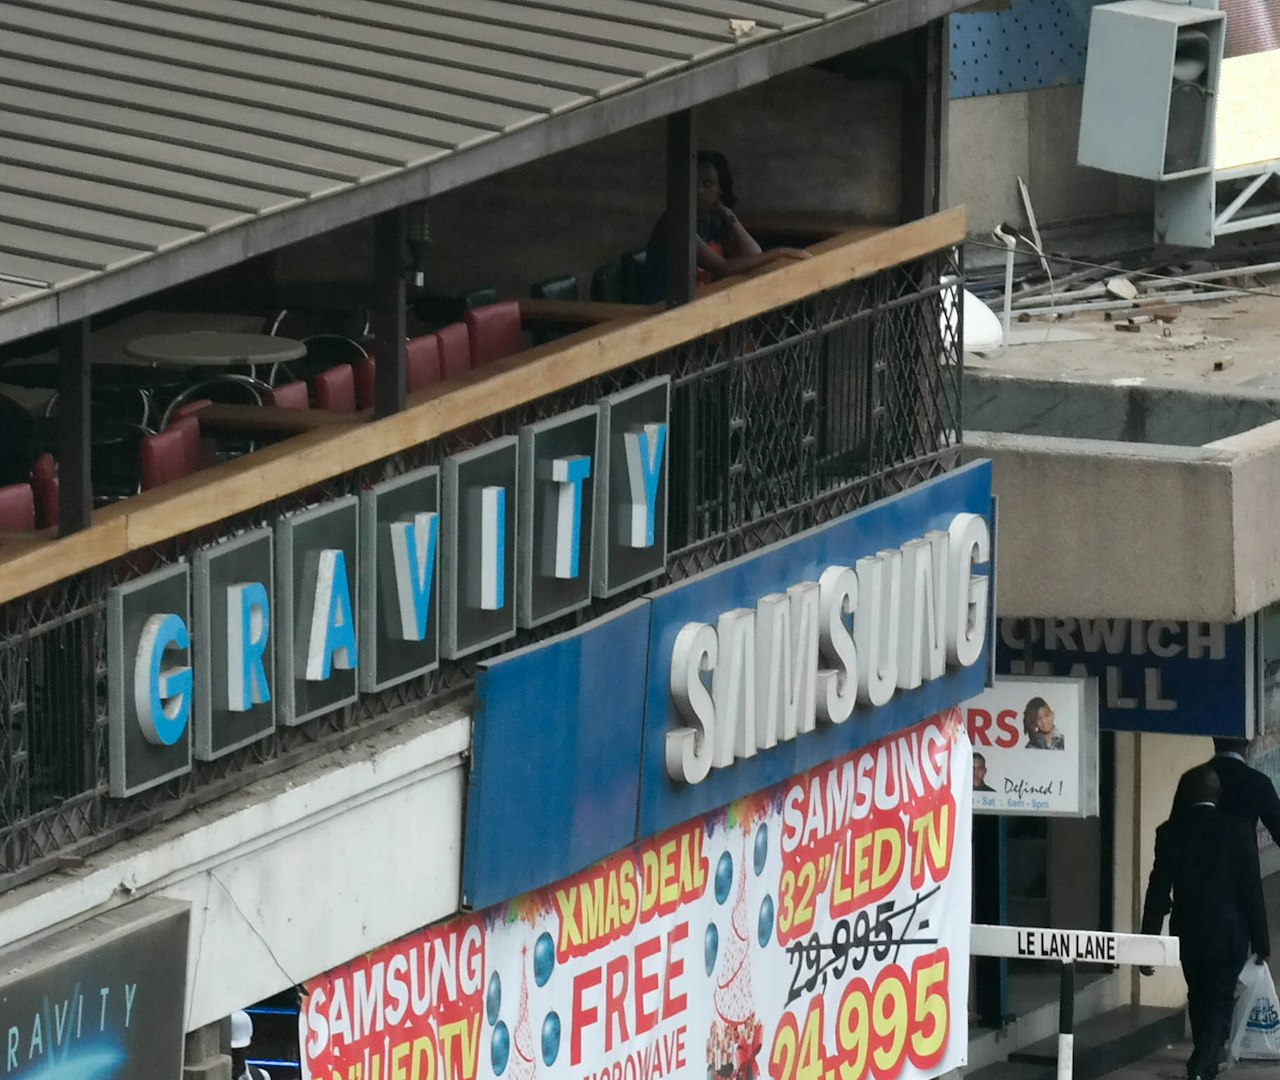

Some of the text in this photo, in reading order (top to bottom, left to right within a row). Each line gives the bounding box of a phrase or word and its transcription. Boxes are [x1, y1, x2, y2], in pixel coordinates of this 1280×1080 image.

[135, 424, 667, 746] GRAVITY
[665, 512, 991, 785] SAMSUNG
[964, 708, 1019, 749] RS
[783, 724, 949, 853] SAMSUNG
[983, 797, 1050, 809] Sat 6am 9pm
[1004, 778, 1053, 800] Defined
[555, 828, 704, 953] XMAS DEAL
[833, 827, 902, 907] LED
[913, 804, 949, 877] TV
[307, 924, 482, 1058] SAMSUNG
[570, 922, 689, 1067] FREE
[1018, 931, 1115, 960] LE LAN LANE
[7, 983, 136, 1072] RAVITY
[439, 1013, 480, 1080] TV
